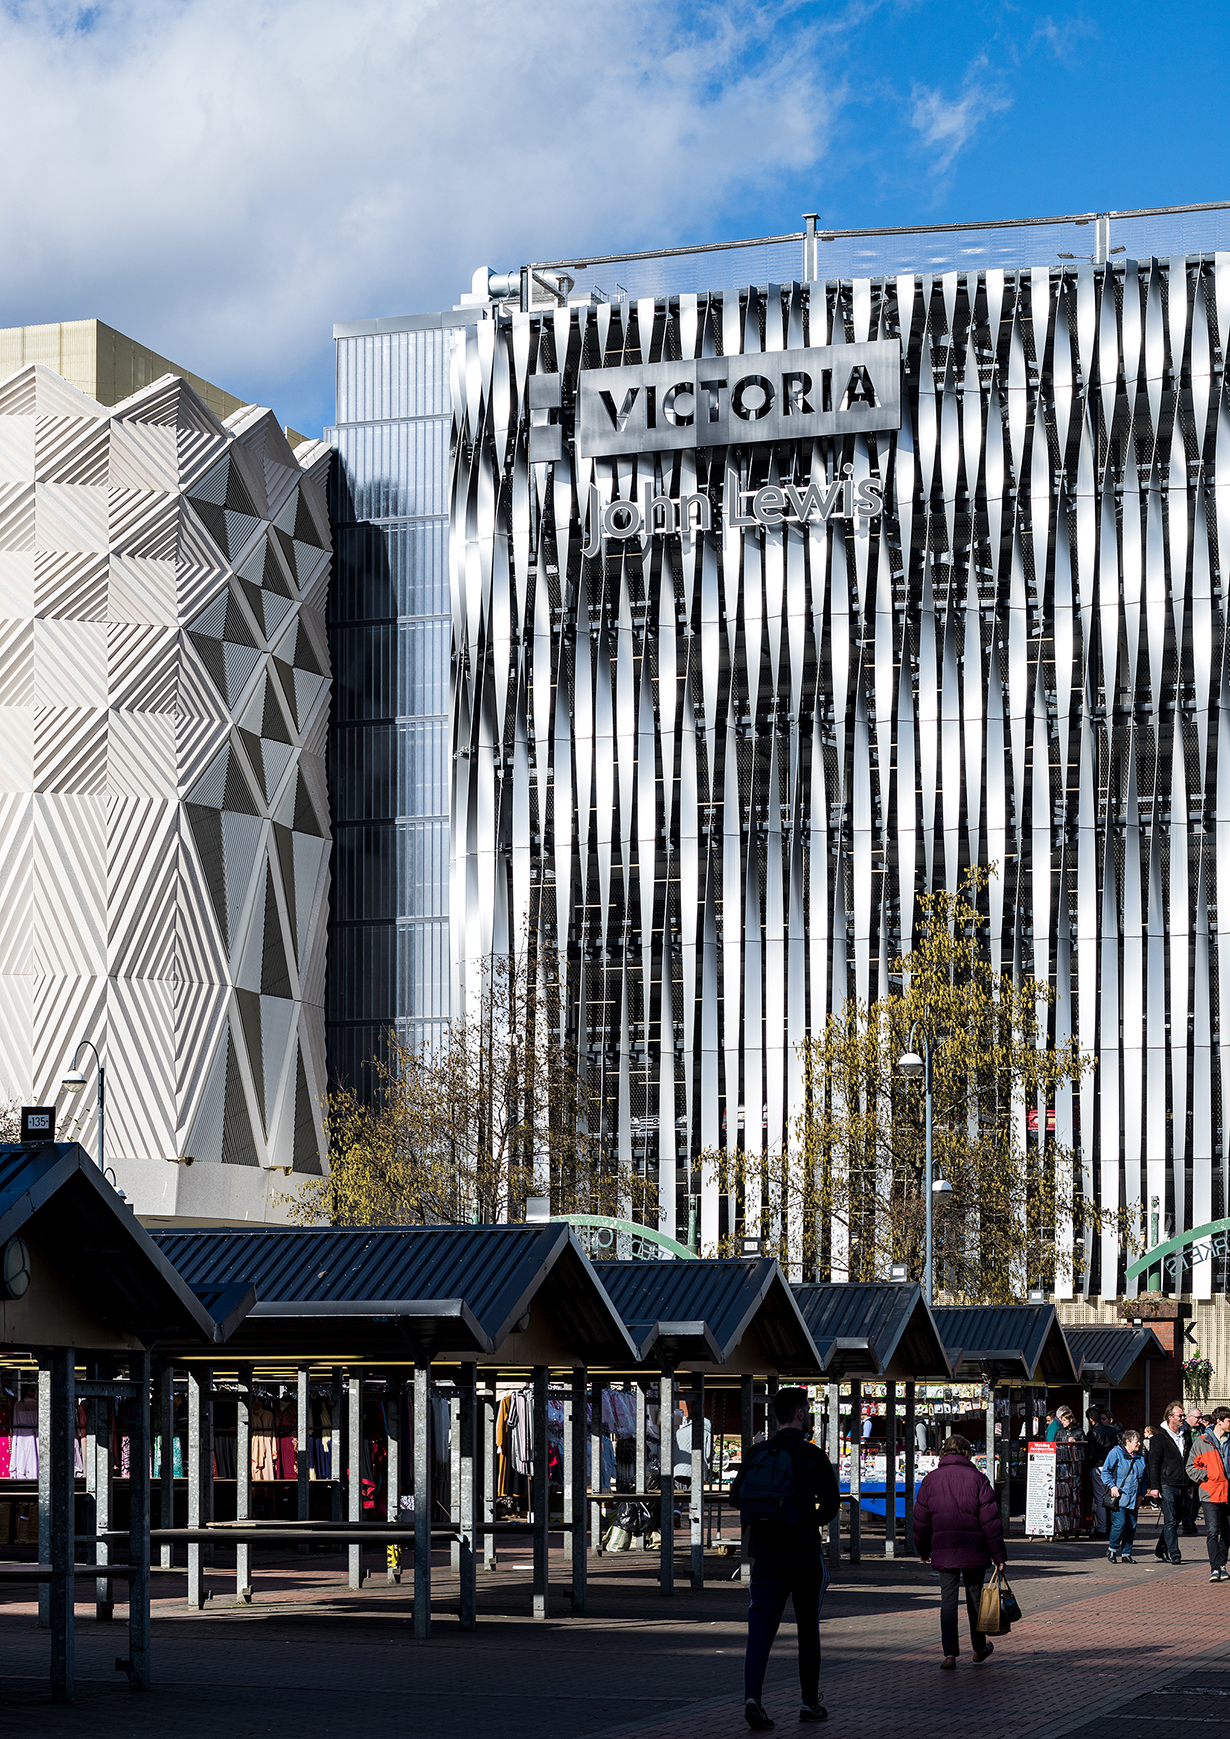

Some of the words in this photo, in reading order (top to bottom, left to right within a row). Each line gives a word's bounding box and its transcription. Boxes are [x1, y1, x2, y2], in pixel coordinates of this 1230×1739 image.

[598, 364, 882, 432] VICTORIA
[580, 481, 711, 558] John
[728, 462, 883, 528] Lewis
[31, 1116, 46, 1127] 135
